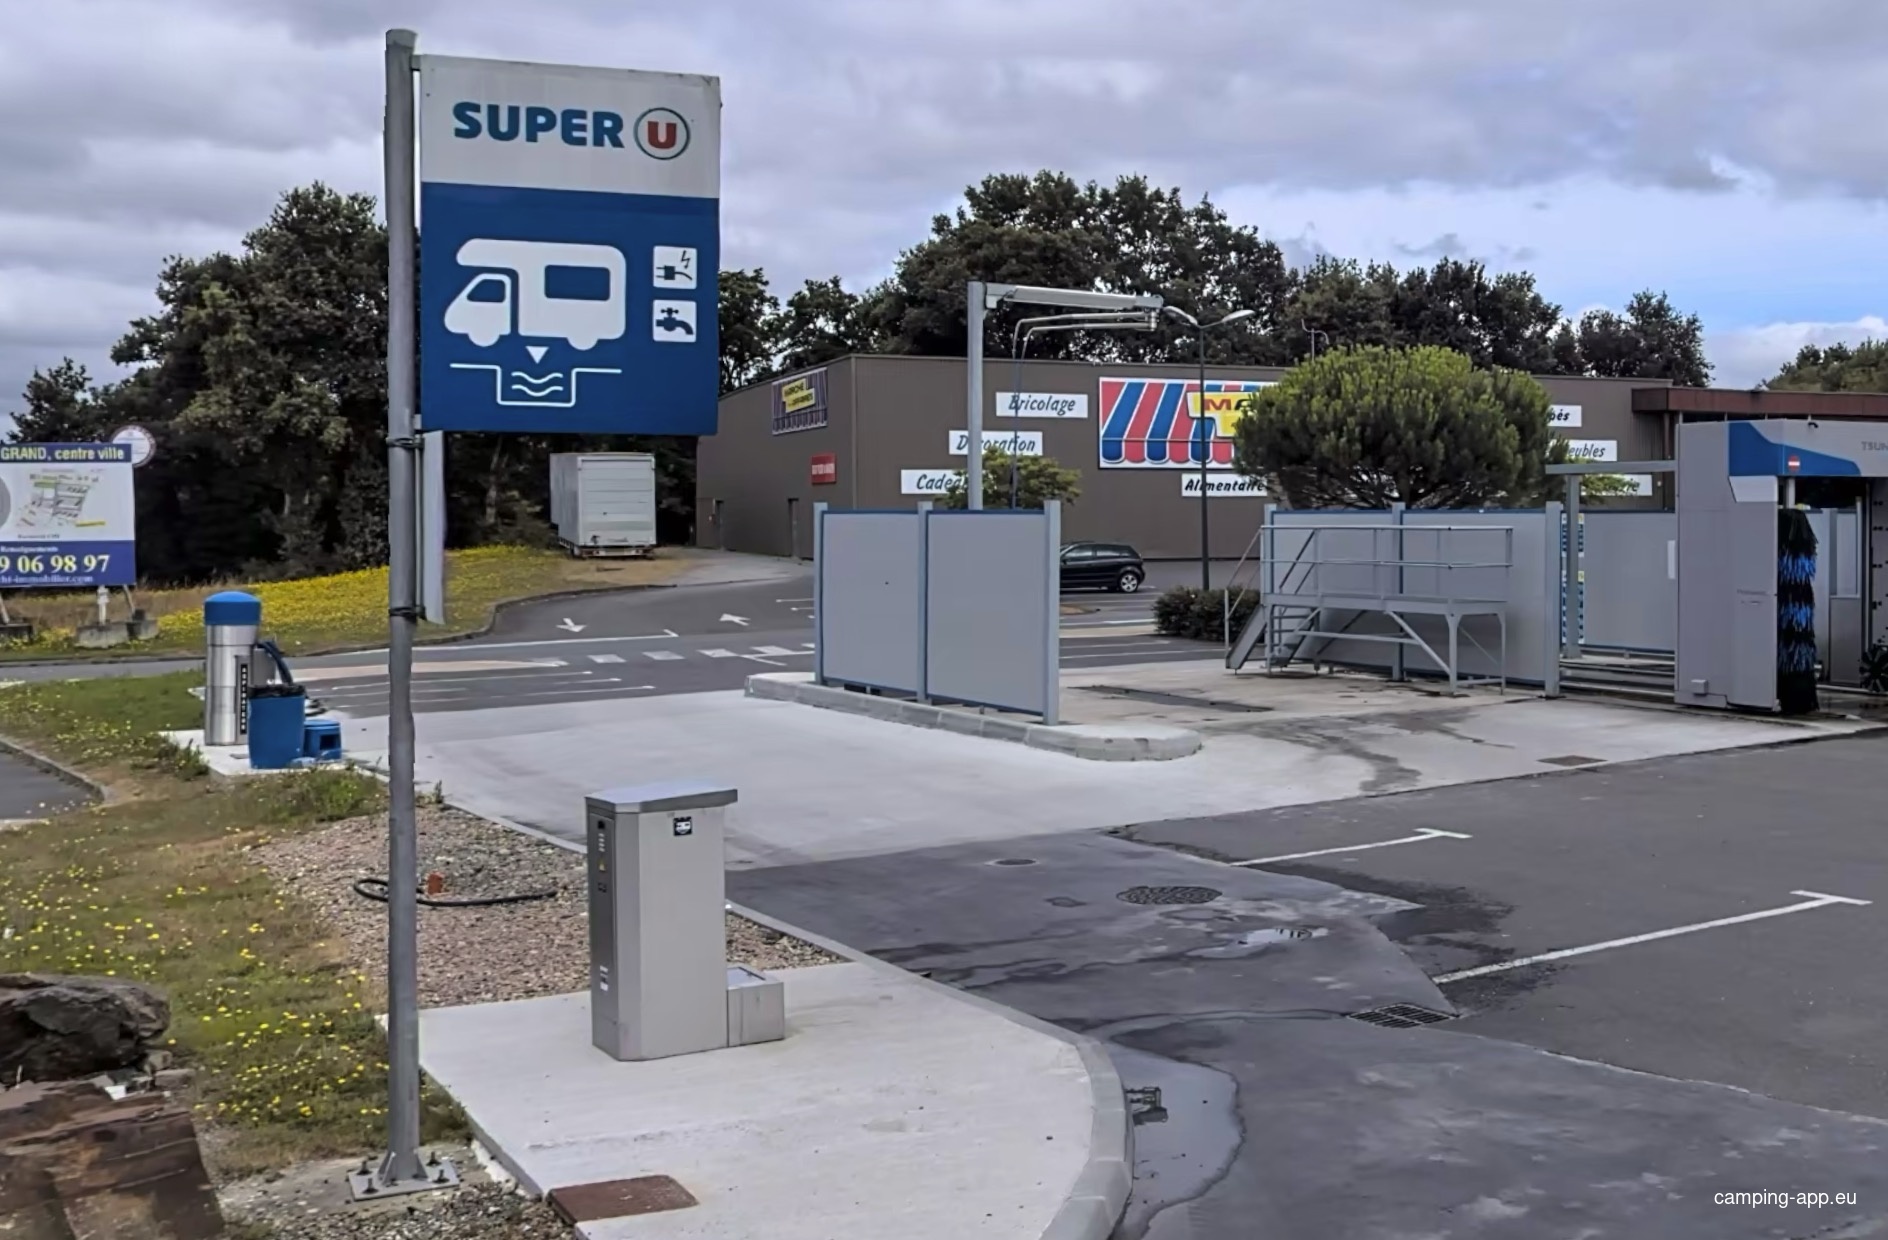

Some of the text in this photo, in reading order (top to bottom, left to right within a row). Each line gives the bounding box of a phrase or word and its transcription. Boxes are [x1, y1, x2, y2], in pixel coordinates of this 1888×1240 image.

[452, 102, 626, 149] SUPER
[1008, 394, 1076, 416] Bricolage
[1548, 408, 1570, 421] bés
[956, 434, 1036, 452] Doration
[1567, 443, 1606, 458] eubles
[55, 447, 95, 460] centre
[97, 446, 125, 460] ville
[916, 473, 966, 490] Cadea
[1185, 478, 1265, 492] Almentaire
[0, 554, 111, 574] 9 06 98 97
